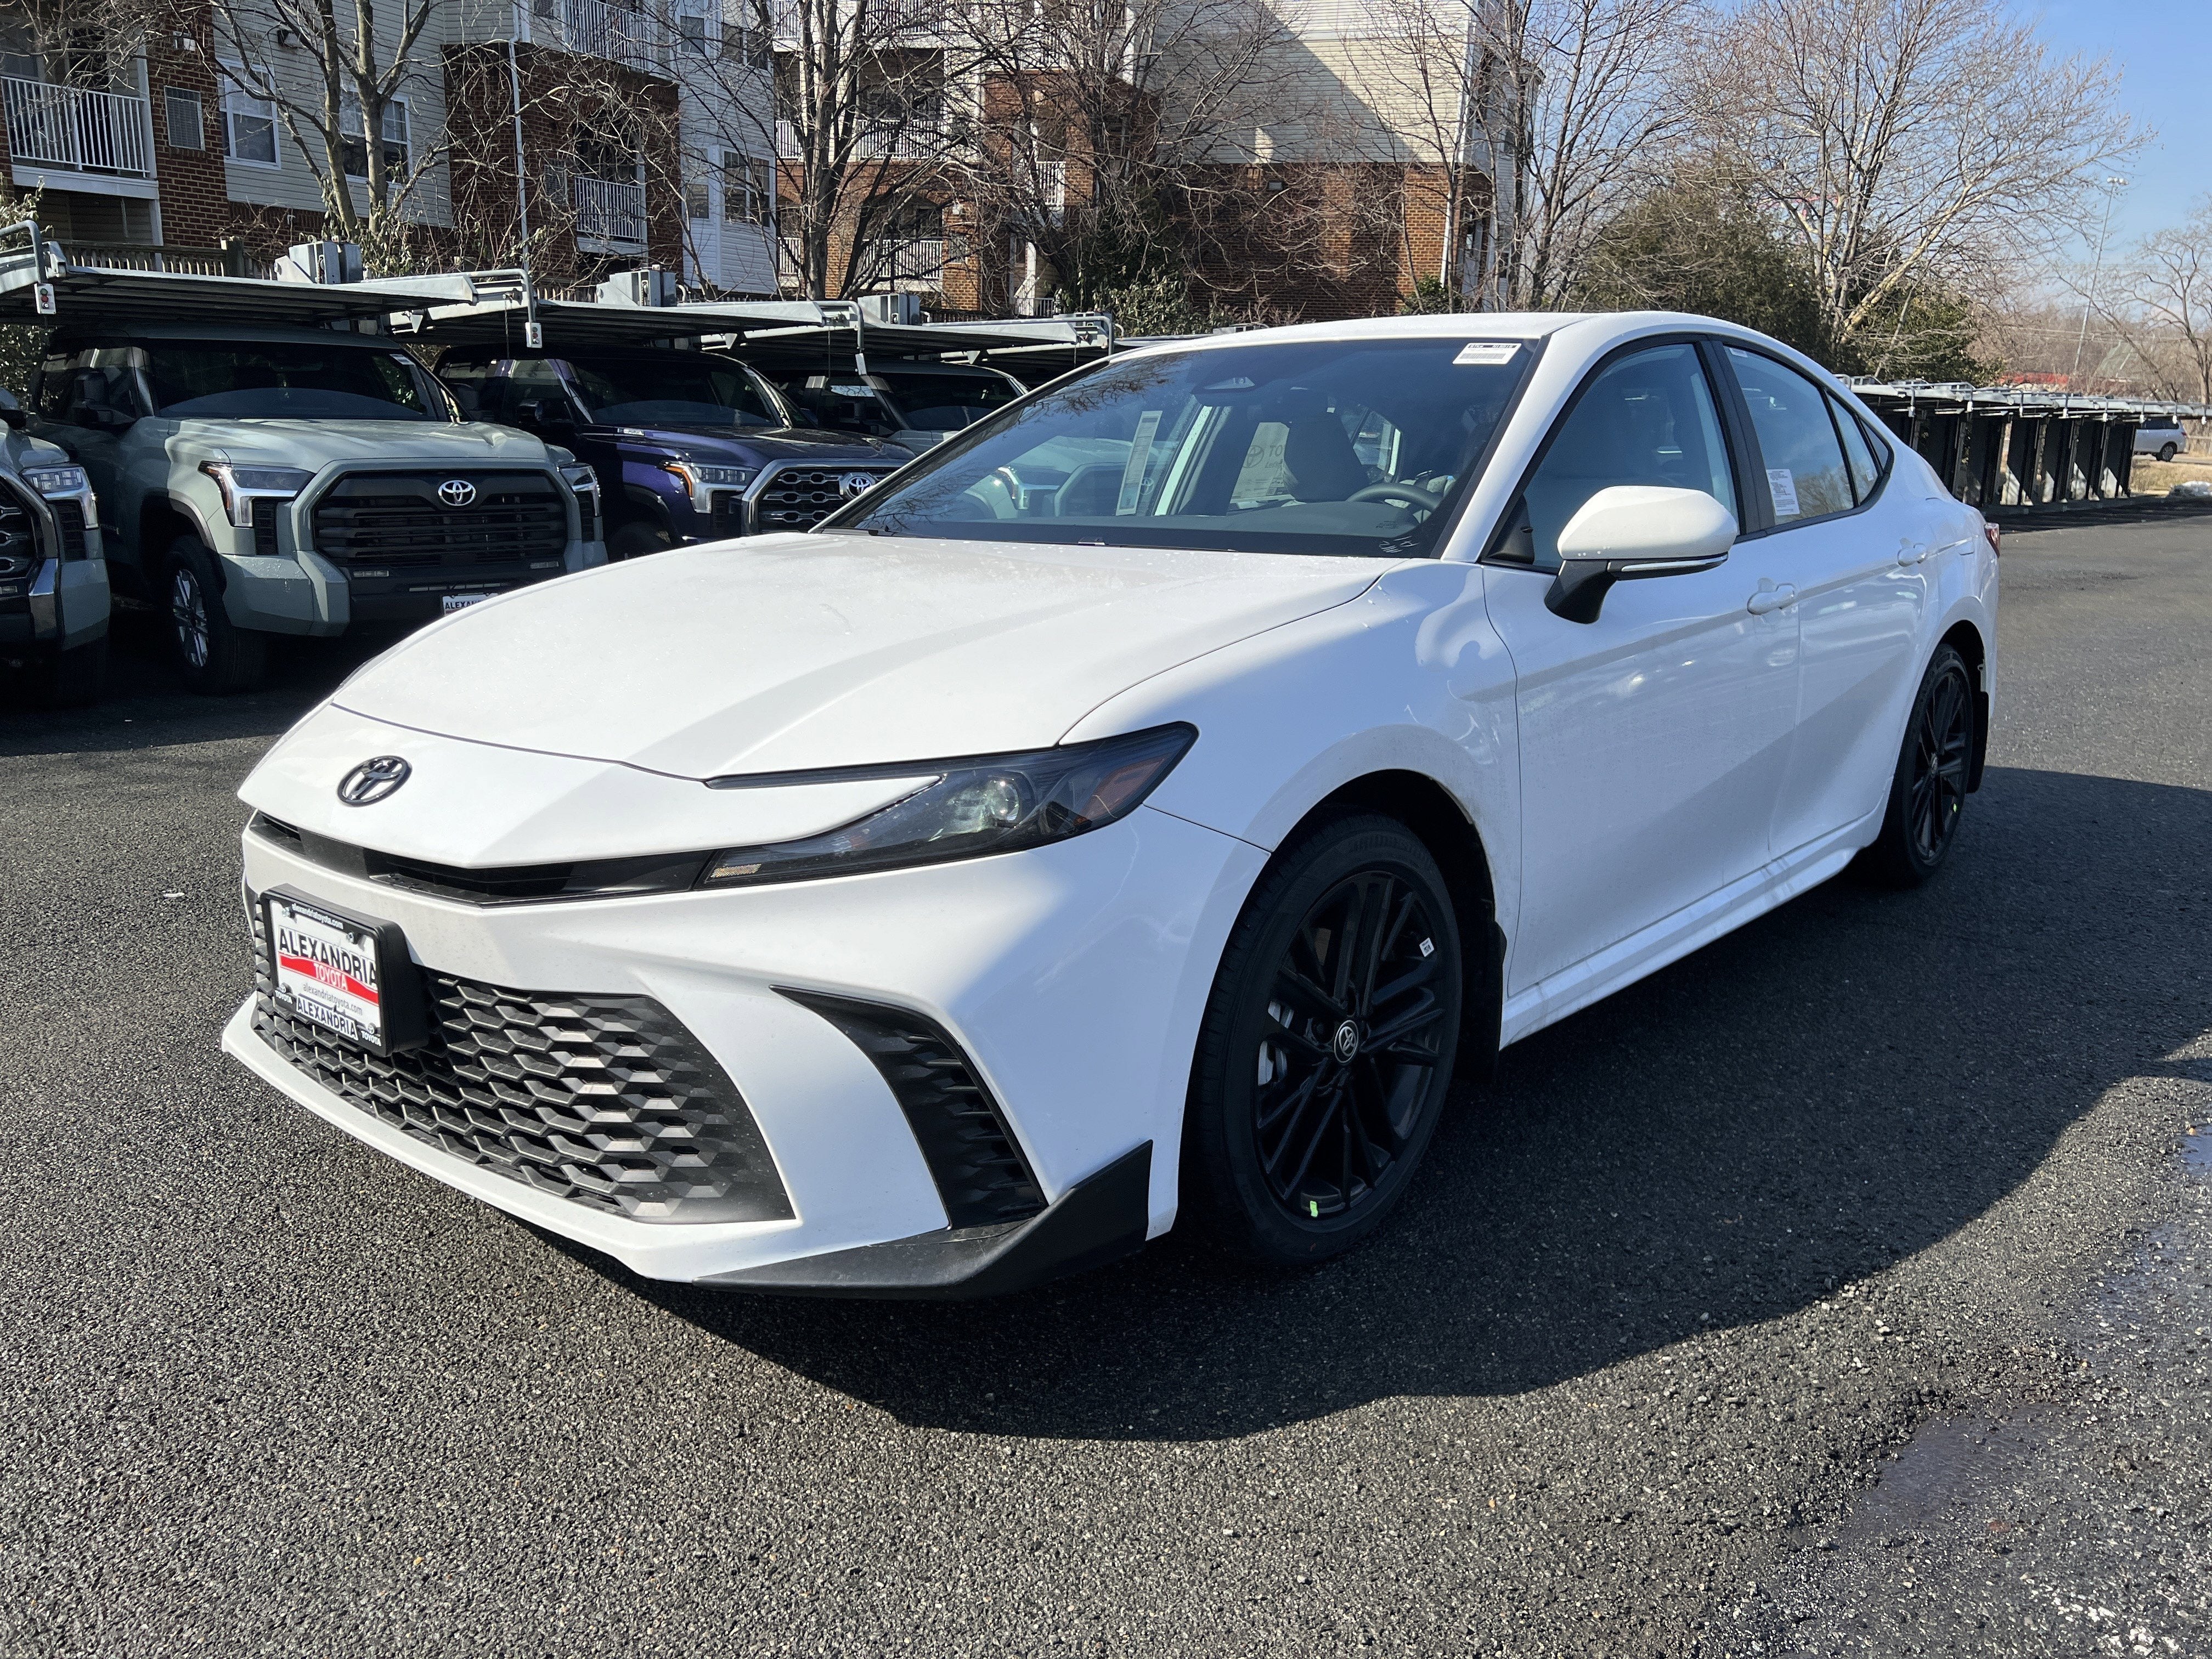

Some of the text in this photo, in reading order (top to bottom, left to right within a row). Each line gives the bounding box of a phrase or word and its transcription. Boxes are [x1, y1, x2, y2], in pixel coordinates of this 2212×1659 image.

[292, 903, 343, 929] alexandriatoyota.com
[280, 928, 377, 986] ALEXANDRIA
[314, 963, 348, 991] TOYOTA
[275, 990, 292, 1004] TOYOTA
[303, 983, 363, 1015] alexandriatoyota.com
[297, 997, 358, 1040] ALEXANDRIA
[361, 1030, 382, 1047] TOYOTA
